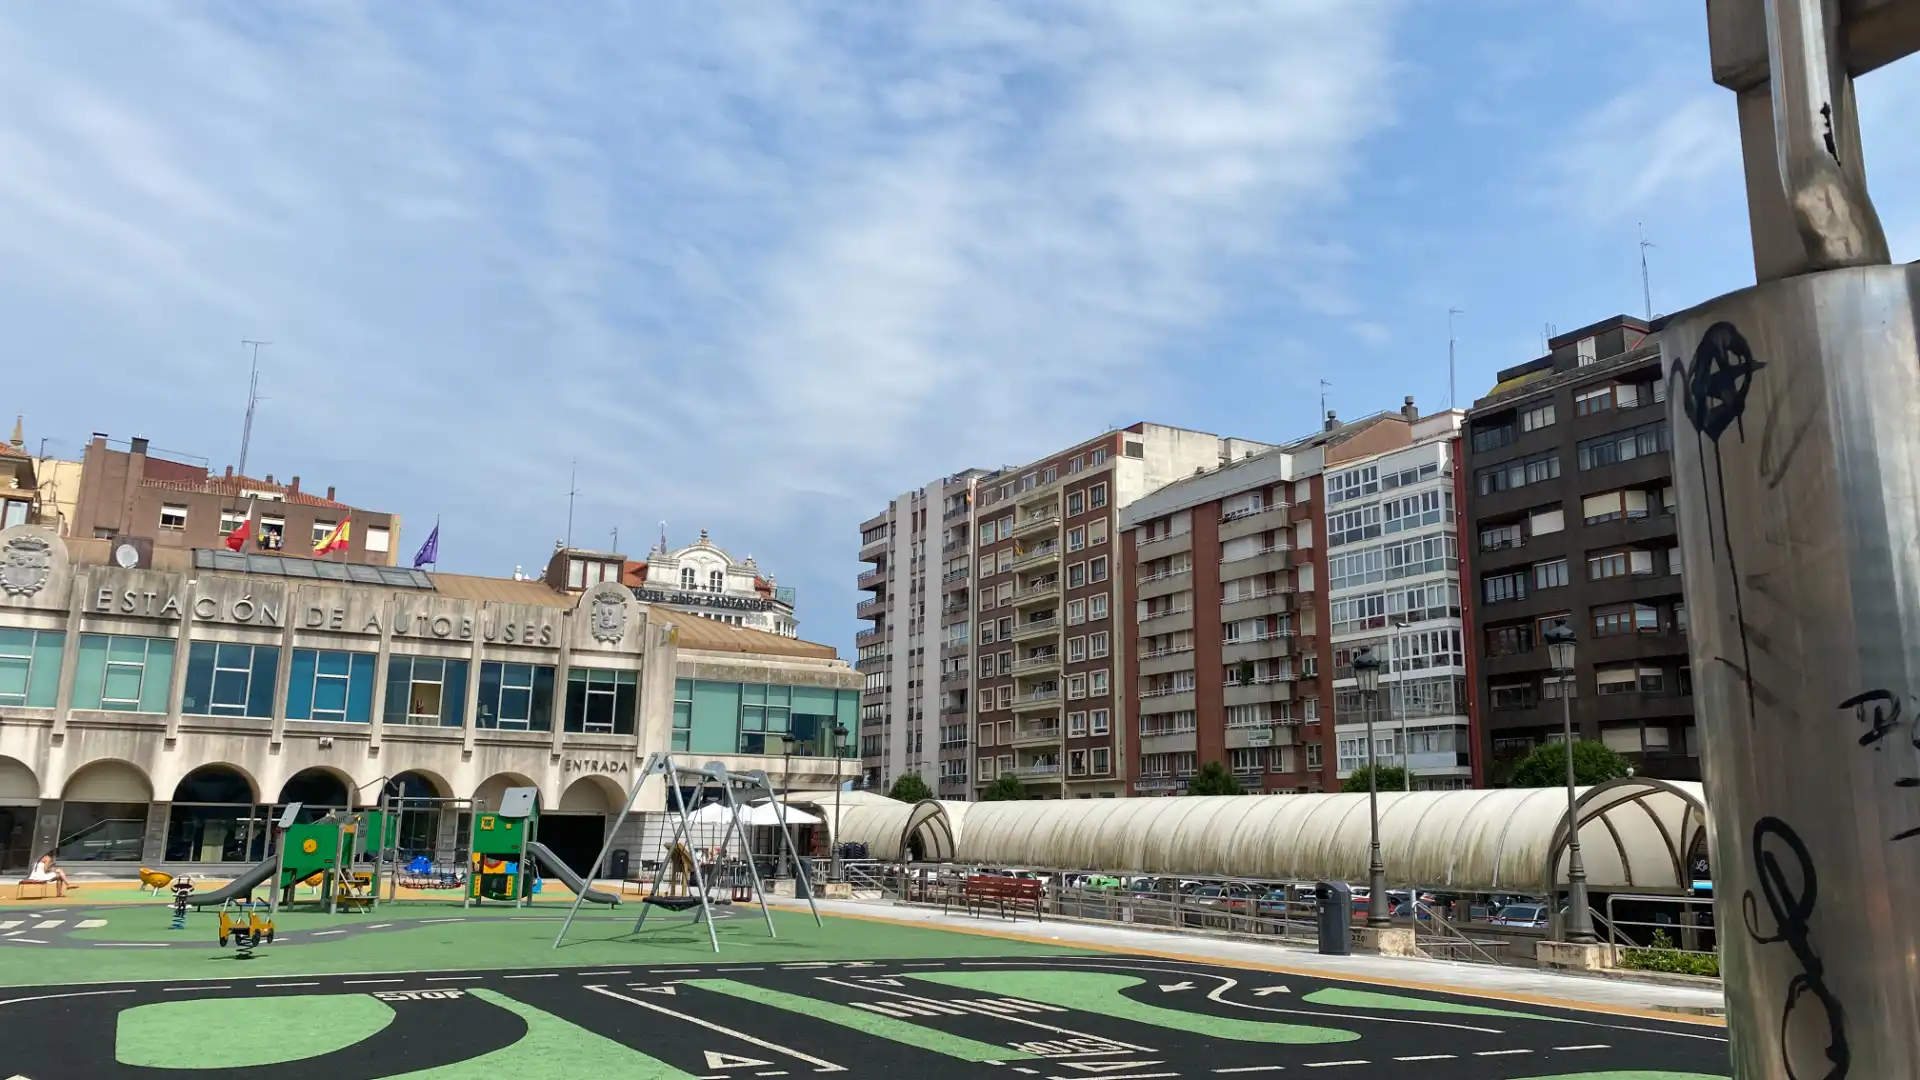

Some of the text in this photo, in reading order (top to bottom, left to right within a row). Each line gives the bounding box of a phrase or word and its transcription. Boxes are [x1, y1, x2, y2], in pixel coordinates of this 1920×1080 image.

[706, 594, 773, 612] SANTANDER
[96, 589, 553, 645] ESTACIÓN DE AUTOBUSES
[564, 760, 628, 773] ENTRADA
[373, 990, 466, 1001] STOP
